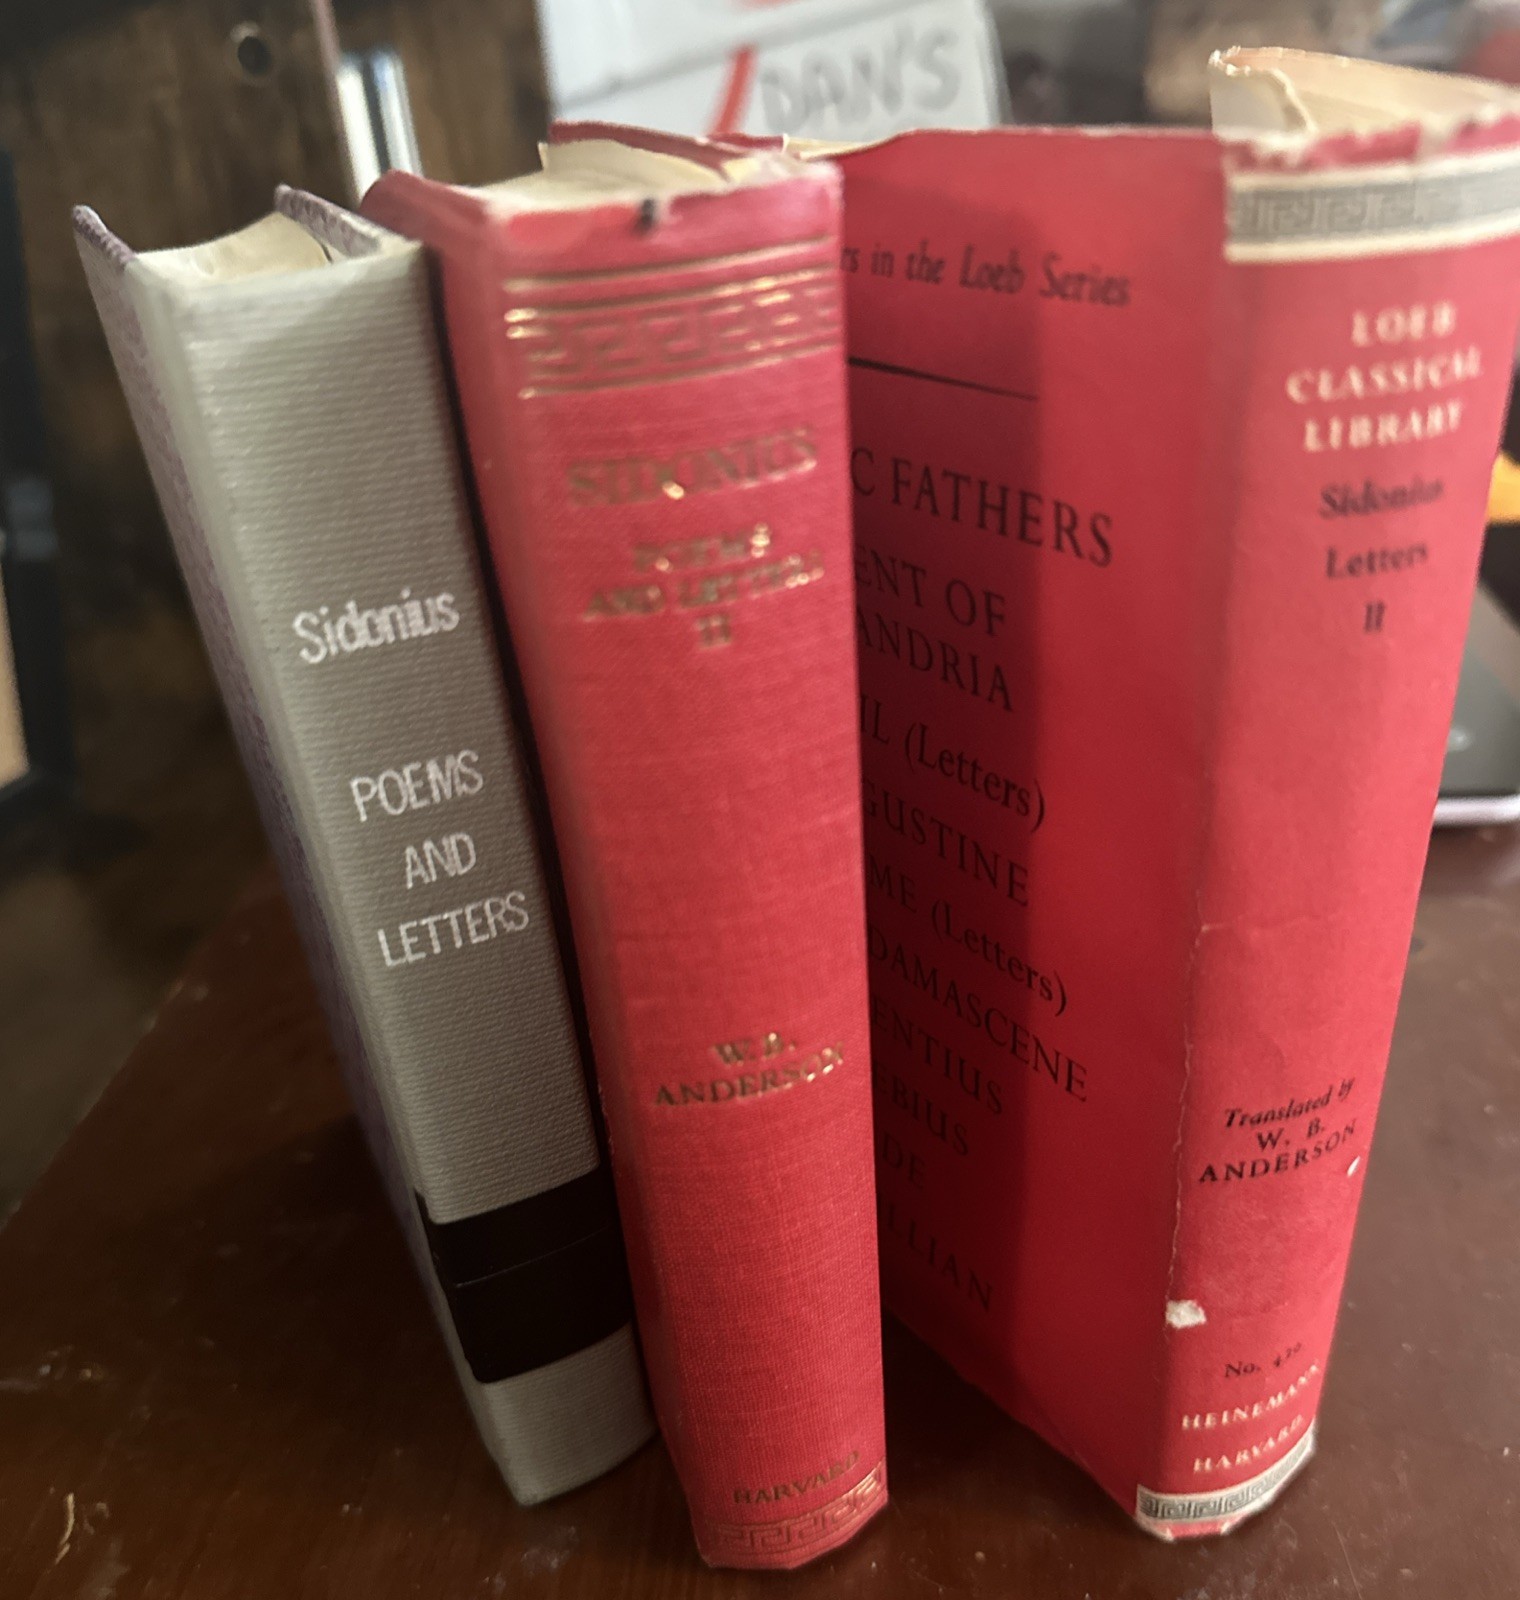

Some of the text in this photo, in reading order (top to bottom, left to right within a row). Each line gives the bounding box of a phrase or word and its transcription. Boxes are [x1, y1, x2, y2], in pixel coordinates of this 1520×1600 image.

[905, 238, 945, 285] the
[959, 244, 1025, 294] Loeb
[1038, 252, 1131, 307] Series
[1352, 300, 1455, 348] LOEB
[1285, 344, 1480, 403] CLASSICAL
[1304, 399, 1462, 451] LIBRARY
[891, 456, 1113, 568] FATHERS
[1319, 476, 1443, 519] Sidonius
[1325, 543, 1428, 579] Letters
[292, 587, 461, 664] Sidonius
[945, 578, 1005, 636] OF
[1364, 601, 1385, 634] II
[350, 750, 484, 822] POEMS
[904, 721, 1045, 833] (Letters)
[405, 832, 476, 889] AND
[377, 891, 529, 967] LETTERS
[931, 899, 1067, 1017] (Letters)
[868, 922, 1087, 1102] DAMASCENE
[656, 1041, 844, 1106] ANDERSON
[1224, 1084, 1333, 1128] Translated
[1200, 1118, 1356, 1182] ANDERSON
[1224, 1361, 1261, 1379] No.
[1193, 1414, 1303, 1473] HARVARD
[733, 1450, 860, 1504] HARVARD
